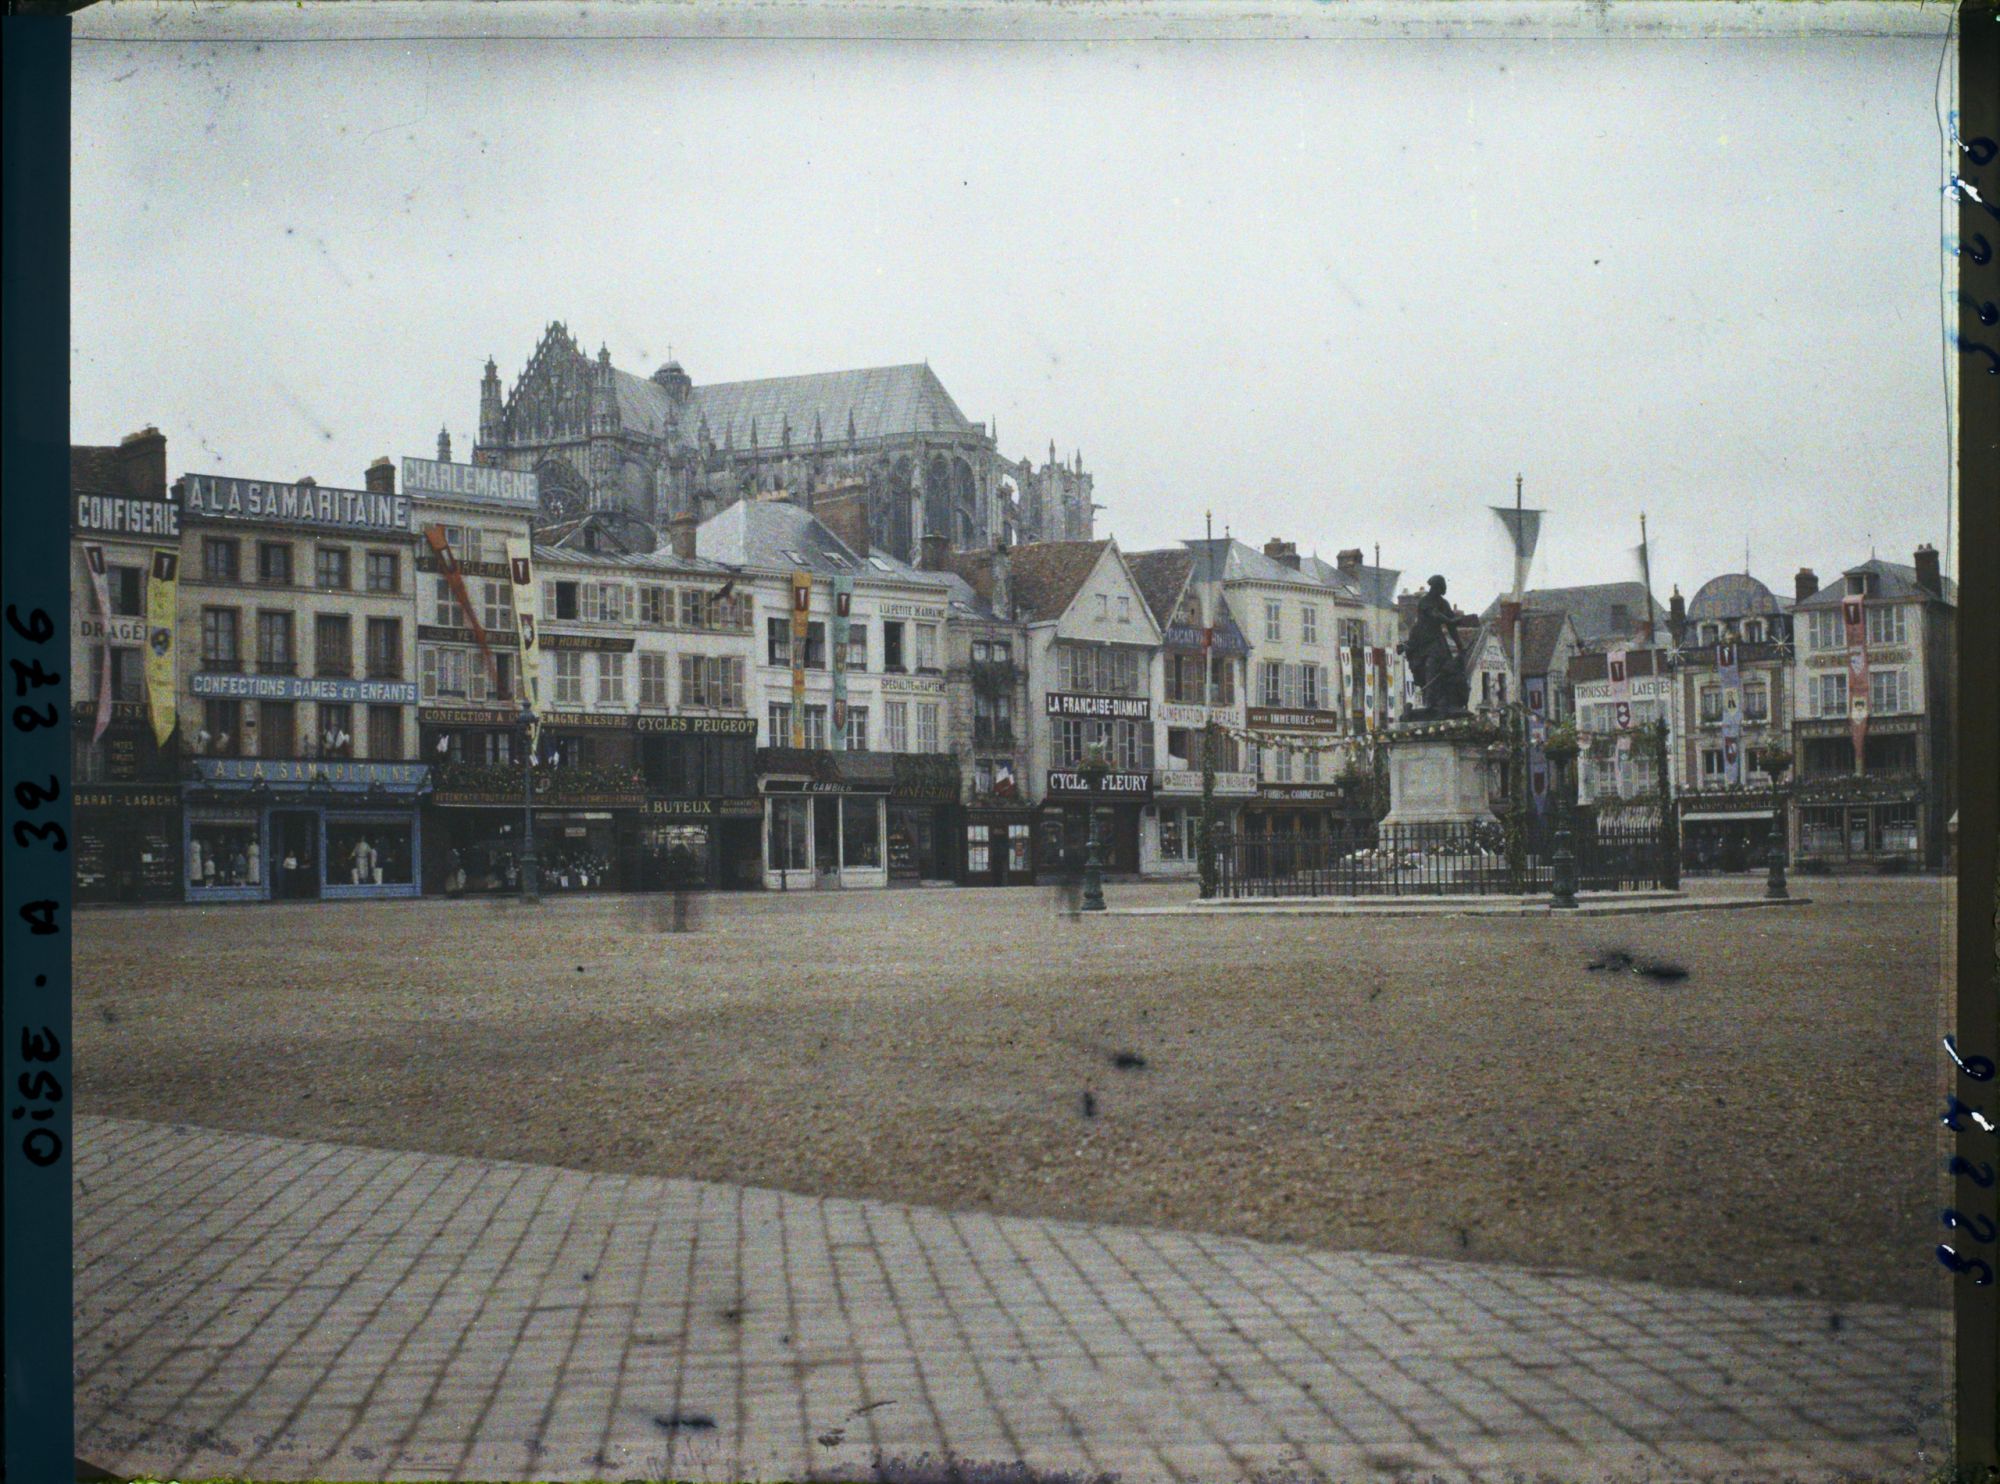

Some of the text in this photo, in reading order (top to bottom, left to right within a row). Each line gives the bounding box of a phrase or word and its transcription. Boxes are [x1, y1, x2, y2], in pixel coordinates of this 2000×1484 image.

[402, 459, 536, 500] CHARLEMAGNE
[189, 478, 407, 527] A LA SAMARITAINE
[78, 495, 180, 536] CONFISERIE
[7, 603, 62, 733] 276
[193, 676, 285, 697] CONFECTIONS
[294, 679, 338, 699] DAMES
[360, 679, 416, 700] ENFANTS
[1048, 695, 1148, 717] LA FRANÇAISE-DIAMANT
[425, 709, 492, 723] CONFECTION
[584, 715, 628, 727] MESURE
[637, 717, 756, 733] CYCLES PEUGEOT
[1270, 713, 1315, 726] IMMEUBLES
[215, 760, 414, 782] A LA SAMARITAINE
[1102, 774, 1148, 791] FLEURY
[1290, 790, 1326, 800] COMMERCE
[653, 801, 712, 814] BUTEUX
[18, 900, 60, 935] A
